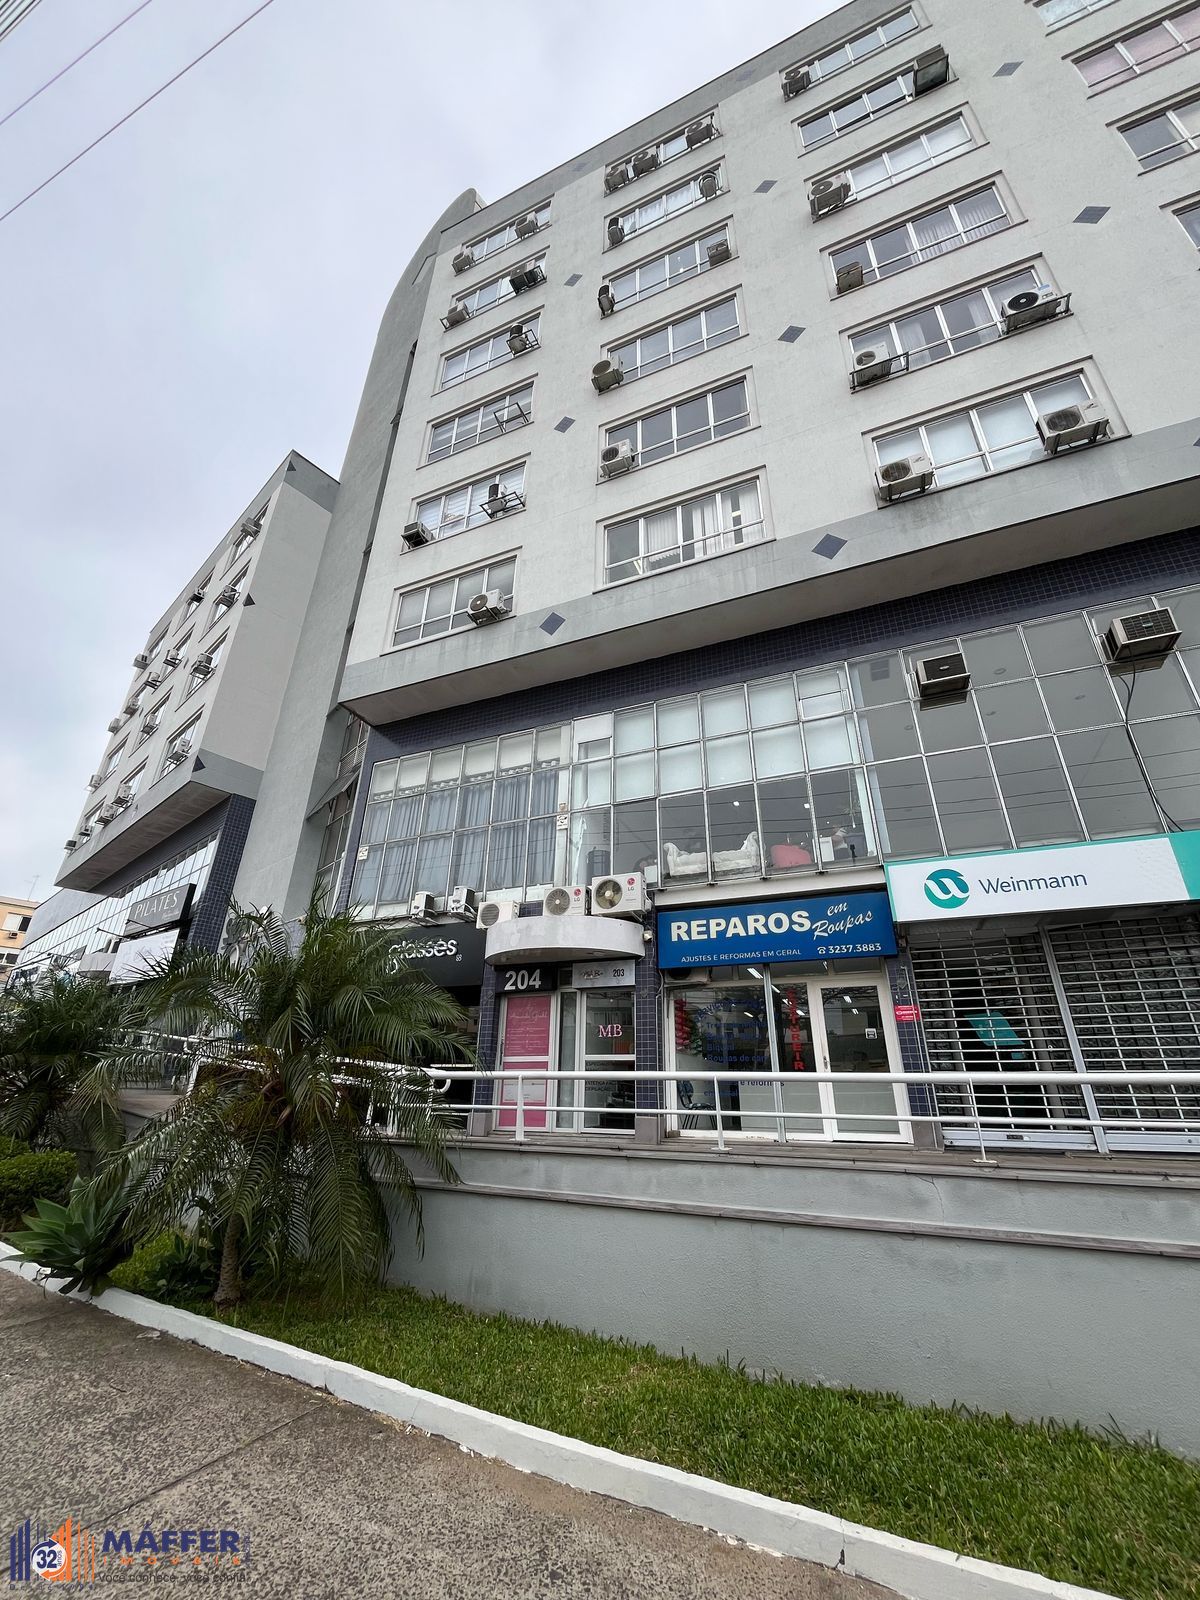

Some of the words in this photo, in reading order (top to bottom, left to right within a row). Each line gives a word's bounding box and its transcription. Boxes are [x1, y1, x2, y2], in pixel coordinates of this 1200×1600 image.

[978, 873, 1088, 895] Weinmann
[133, 890, 180, 920] PILATES
[670, 909, 812, 943] REPAROS
[826, 902, 849, 917] em
[811, 909, 873, 941] Roupas
[680, 954, 712, 964] AJUSTES
[713, 954, 719, 962] E
[719, 951, 761, 961] REFORMAS
[762, 950, 775, 958] EM
[775, 948, 802, 957] GERAL
[827, 942, 882, 955] 3237.3883
[503, 968, 542, 991] 204
[612, 968, 625, 978] 203
[597, 1023, 623, 1038] MB
